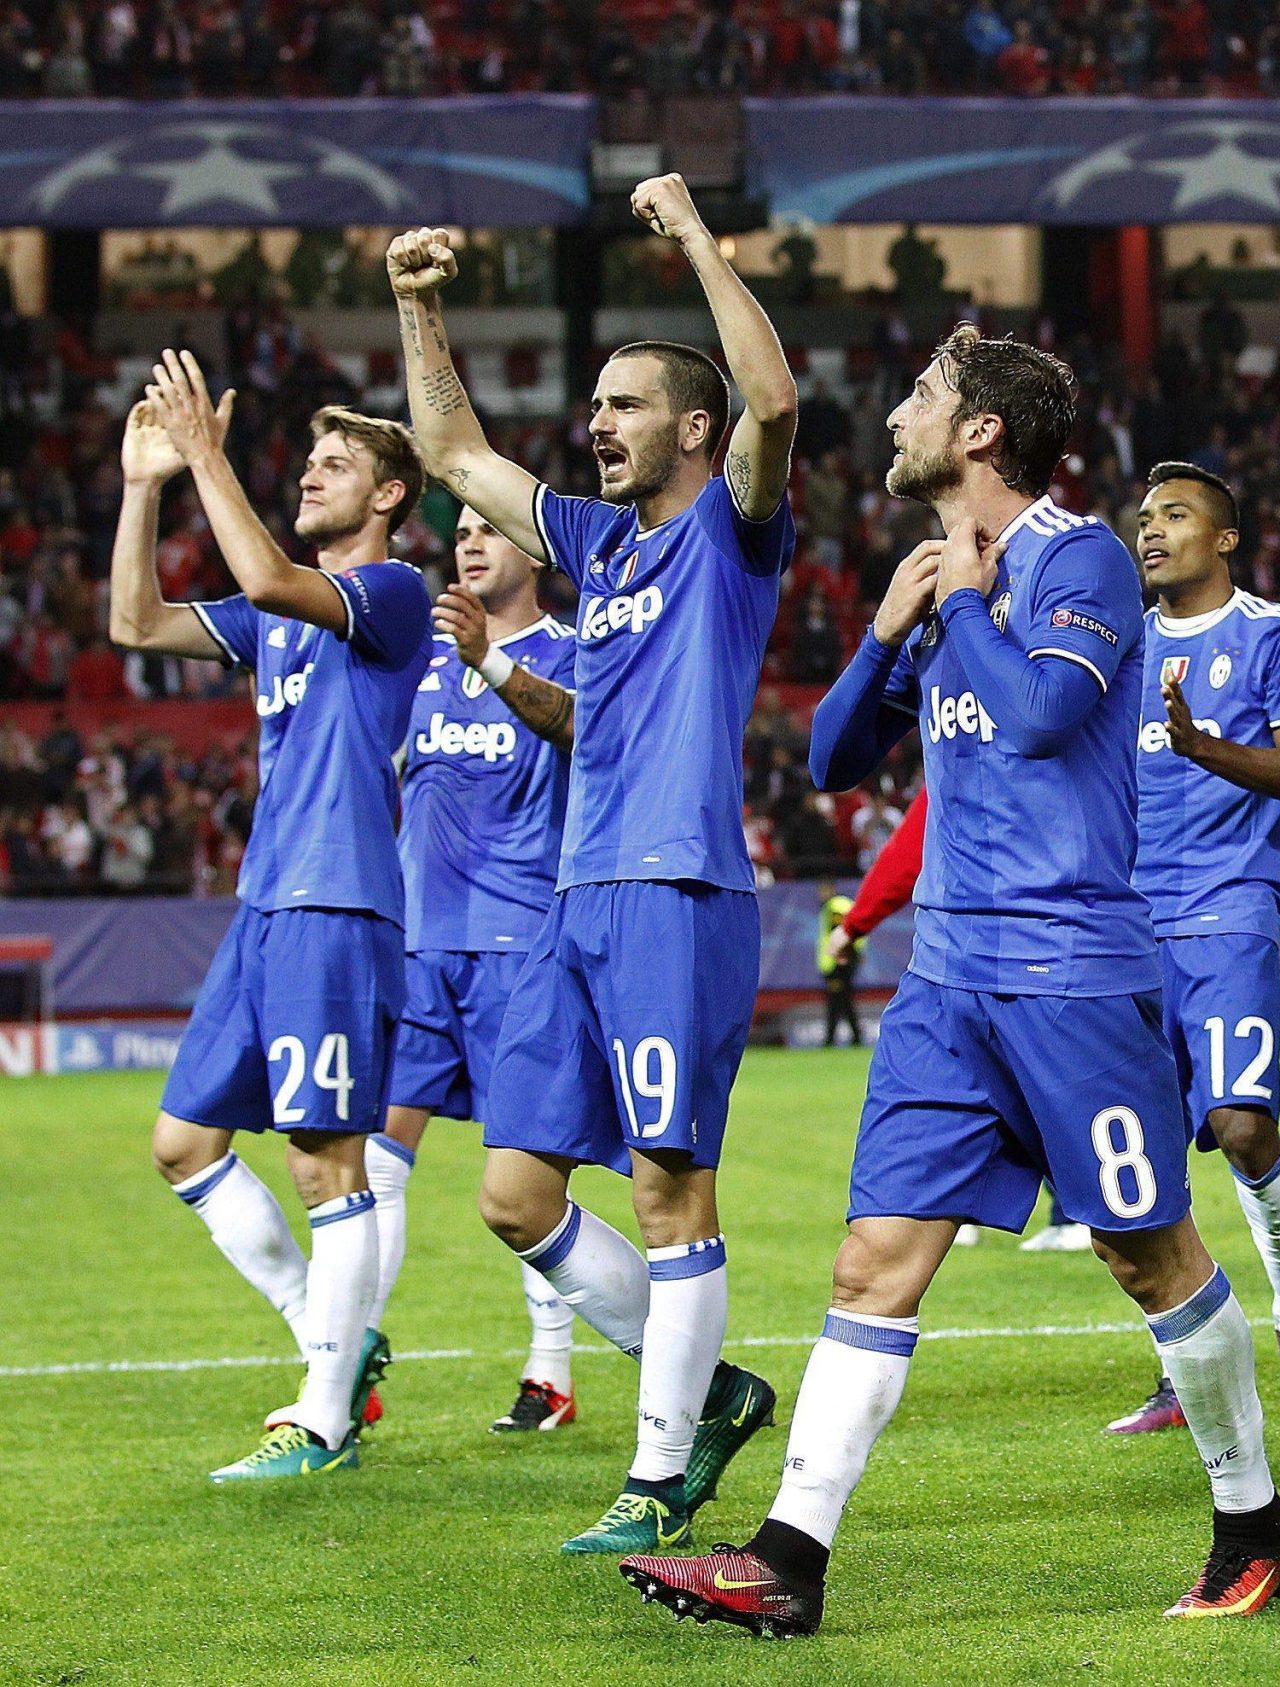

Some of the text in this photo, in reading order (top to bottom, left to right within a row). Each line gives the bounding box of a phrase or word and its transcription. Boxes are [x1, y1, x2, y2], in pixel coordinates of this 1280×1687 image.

[1072, 614, 1119, 645] RESPECT
[415, 711, 518, 763] Jeep
[267, 1032, 355, 1124] 24
[612, 1036, 677, 1139] 19
[1203, 1015, 1275, 1101] 12
[1090, 1104, 1158, 1219] 8
